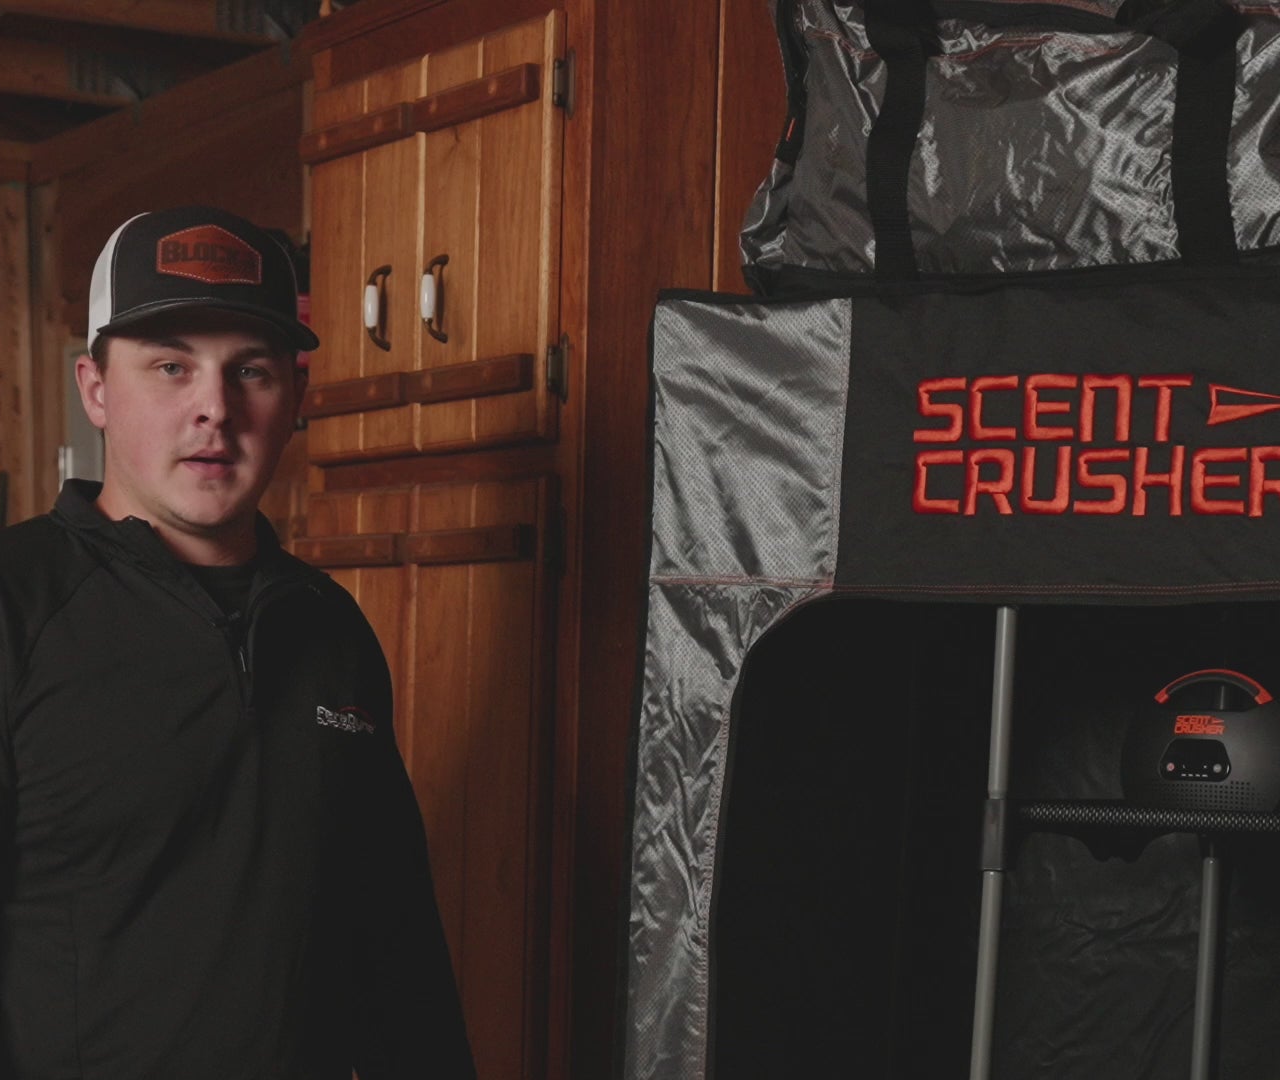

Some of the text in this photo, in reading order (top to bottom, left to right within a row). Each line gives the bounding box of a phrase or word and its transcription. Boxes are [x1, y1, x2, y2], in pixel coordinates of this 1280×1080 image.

[912, 373, 1195, 442] SCENT
[1175, 714, 1214, 726] SCENT
[1174, 723, 1225, 736] CRUSHER
